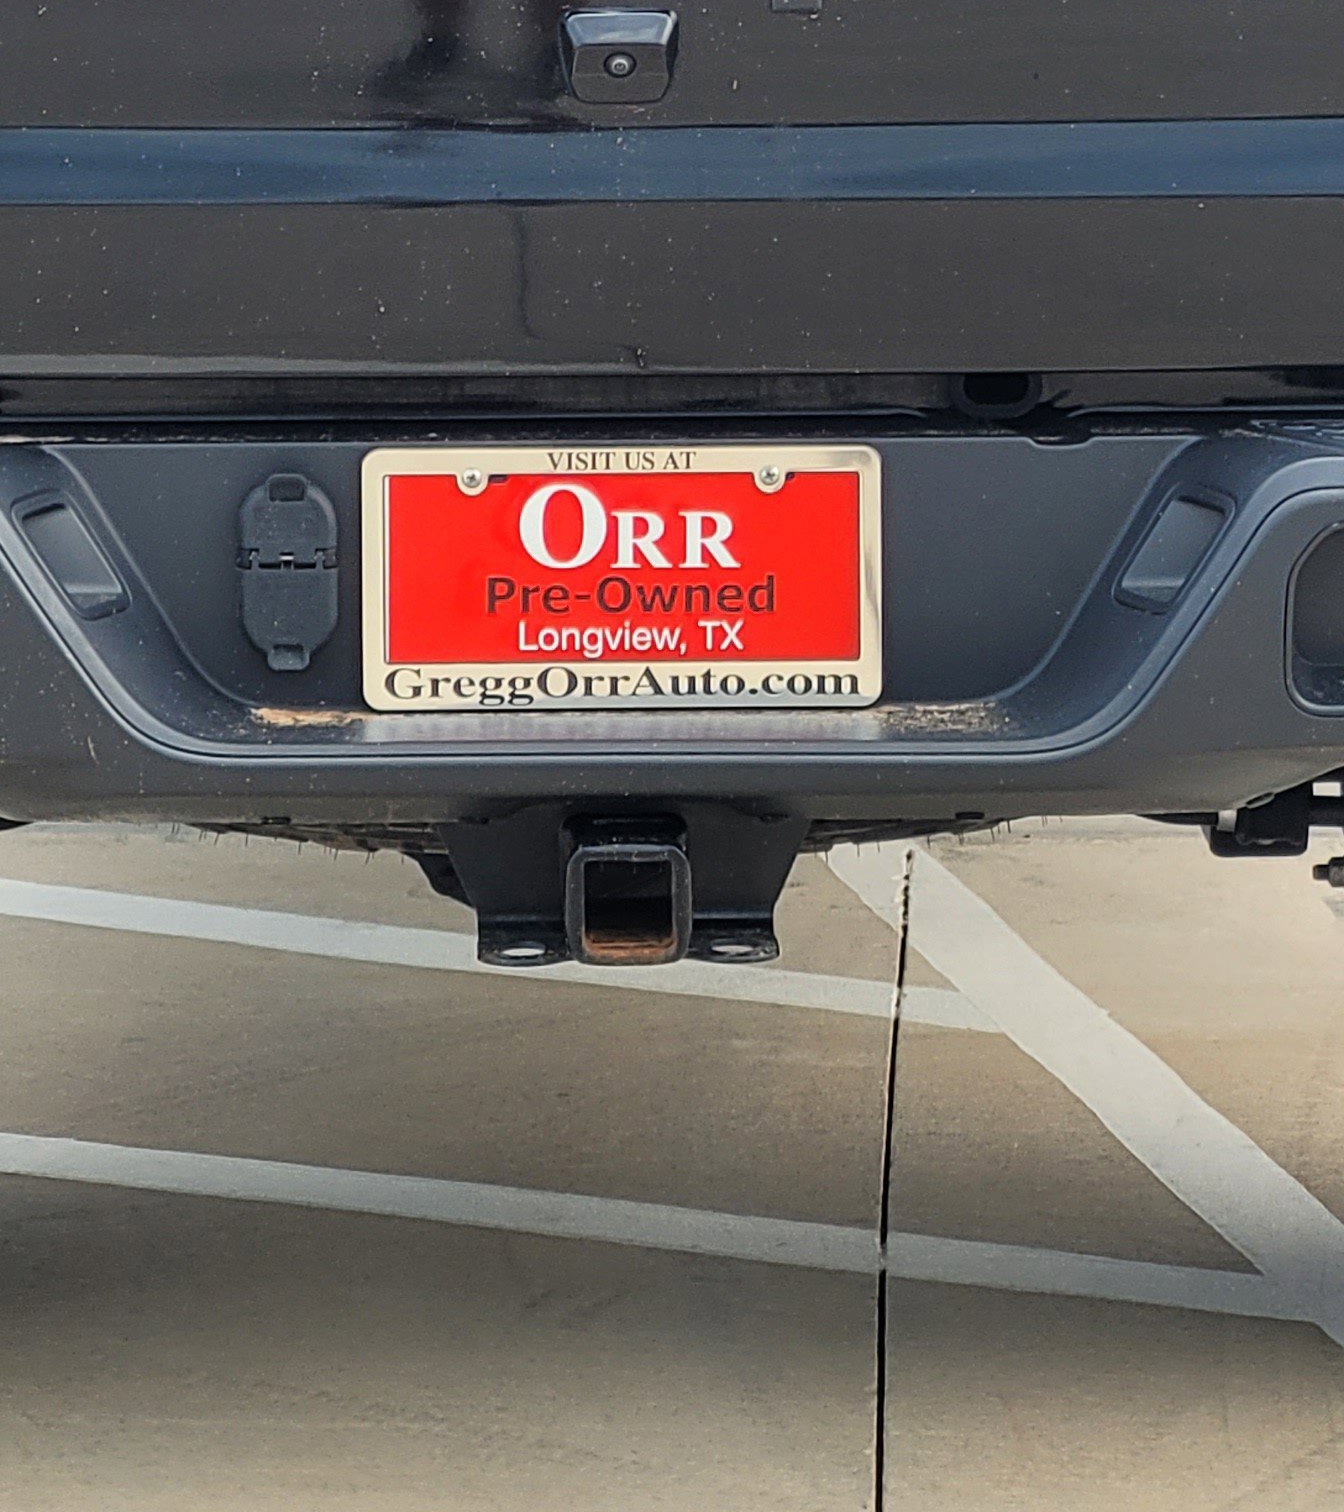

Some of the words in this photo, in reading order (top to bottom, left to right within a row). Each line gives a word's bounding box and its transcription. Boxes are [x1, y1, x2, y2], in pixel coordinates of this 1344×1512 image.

[547, 452, 615, 471] VISIT
[624, 452, 656, 471] US
[662, 451, 697, 470] AT
[486, 575, 775, 614] Pre-Owned
[518, 621, 687, 658] Longview,
[698, 620, 744, 651] TX
[384, 666, 860, 706] GreggOrrAuto.com
